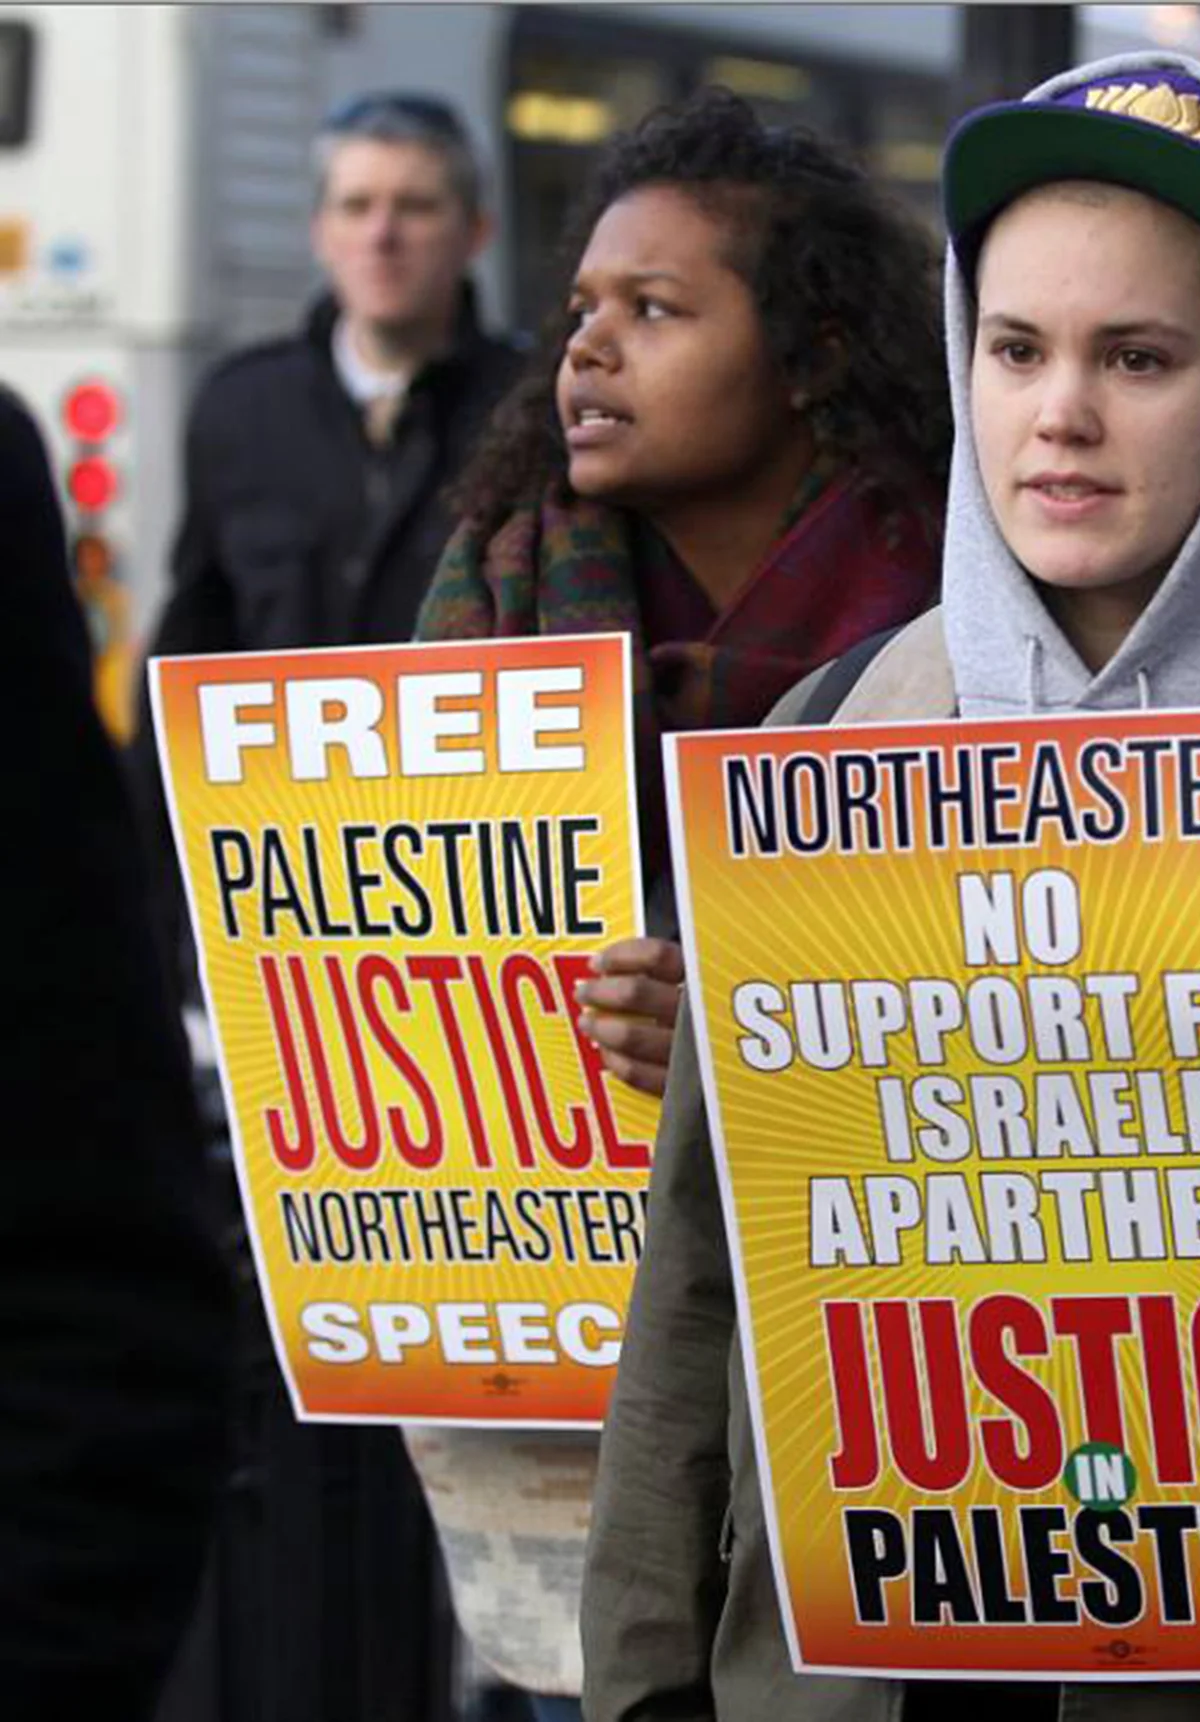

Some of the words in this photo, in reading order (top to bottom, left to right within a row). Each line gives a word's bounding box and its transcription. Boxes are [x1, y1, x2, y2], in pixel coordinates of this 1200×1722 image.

[198, 665, 585, 784] FREE
[210, 819, 604, 938] PALESTINE
[957, 867, 1081, 967] NO
[261, 955, 650, 1171] JUSTICE
[732, 974, 1139, 1071] SUPPORT
[279, 1188, 649, 1262] NORTHEASTER
[300, 1301, 622, 1366] SPEEC
[1075, 1453, 1127, 1501] IN
